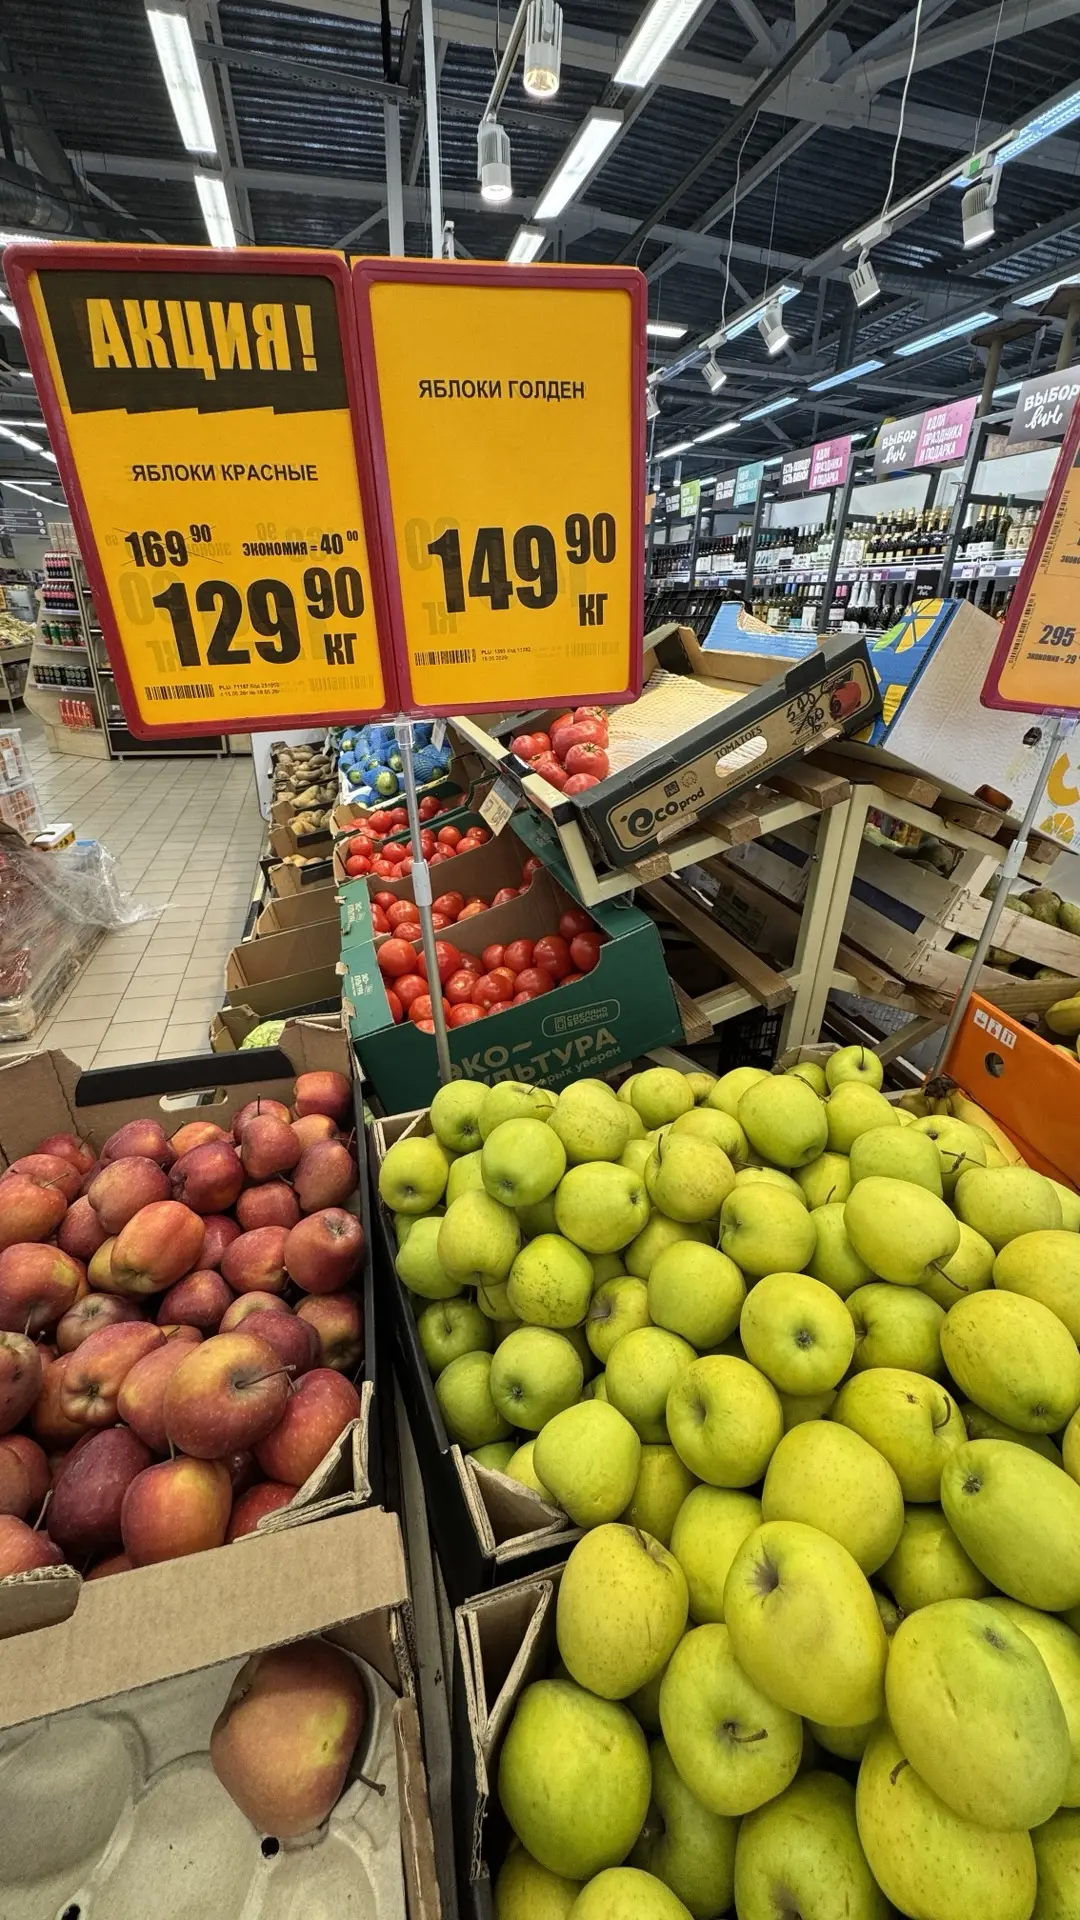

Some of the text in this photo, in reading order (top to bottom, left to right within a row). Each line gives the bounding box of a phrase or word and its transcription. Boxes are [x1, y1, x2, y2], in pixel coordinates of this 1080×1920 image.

[86, 298, 318, 380] АКЦИЯ!
[419, 379, 585, 402] ЯБЛОКИ ГОЛДЕН
[1024, 384, 1080, 412] ВЫБОР
[882, 430, 917, 450] ВЫБОР
[922, 424, 964, 447] ПРАЗДНИКА
[924, 441, 957, 461] ПОДАРКА
[132, 464, 318, 481] ЯБЛОКИ КРАСНЫЕ
[125, 530, 189, 567] 169
[189, 524, 212, 542] 90
[242, 542, 308, 556] ЭКОНОМИЯ
[320, 533, 344, 554] 40
[346, 530, 359, 541] 00
[428, 512, 616, 614] 149 90
[152, 566, 365, 666] 129 90
[1039, 625, 1076, 647] 295
[1064, 654, 1077, 664] 29
[714, 726, 763, 760] TOMATOES
[566, 1006, 608, 1022] СДЕЛАНО
[575, 1046, 621, 1073] уверен
